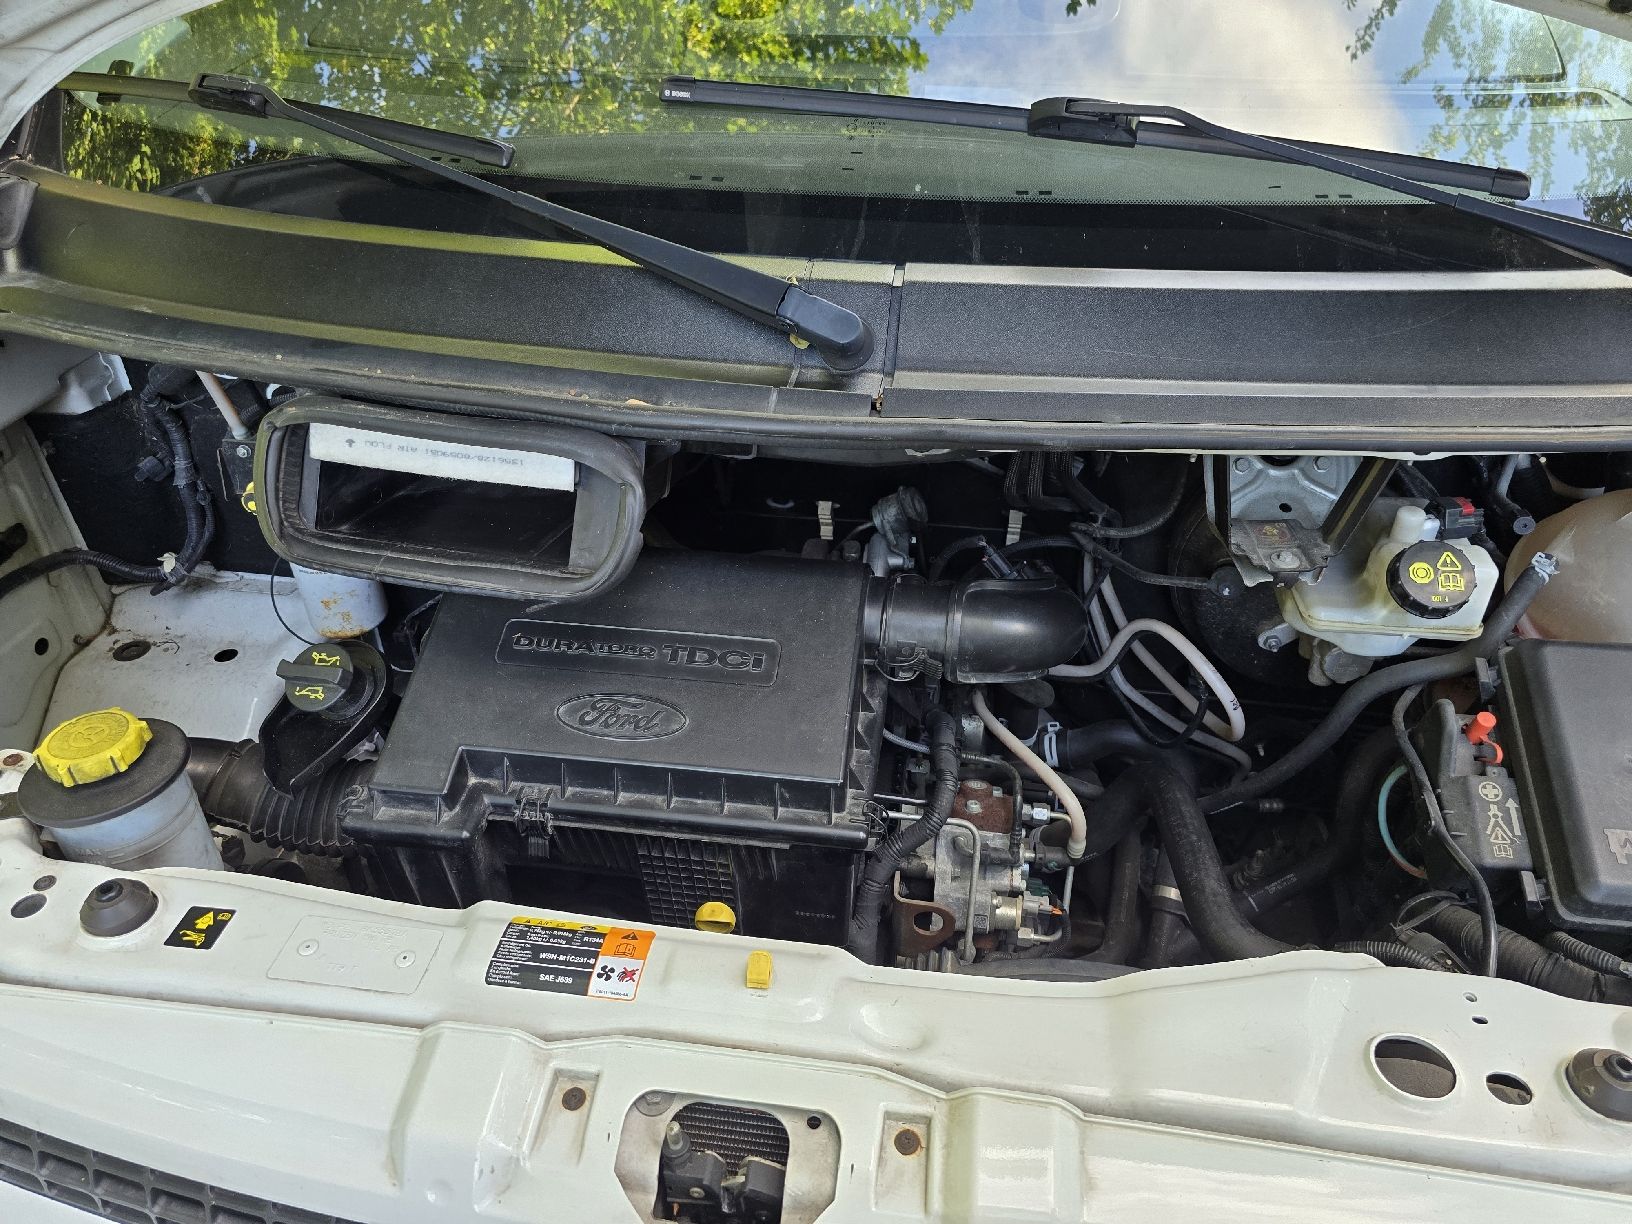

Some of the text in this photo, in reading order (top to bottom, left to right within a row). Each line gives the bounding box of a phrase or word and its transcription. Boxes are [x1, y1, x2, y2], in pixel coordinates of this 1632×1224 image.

[662, 643, 766, 672] TDCi
[577, 698, 666, 733] Ford
[539, 973, 555, 982] SAE
